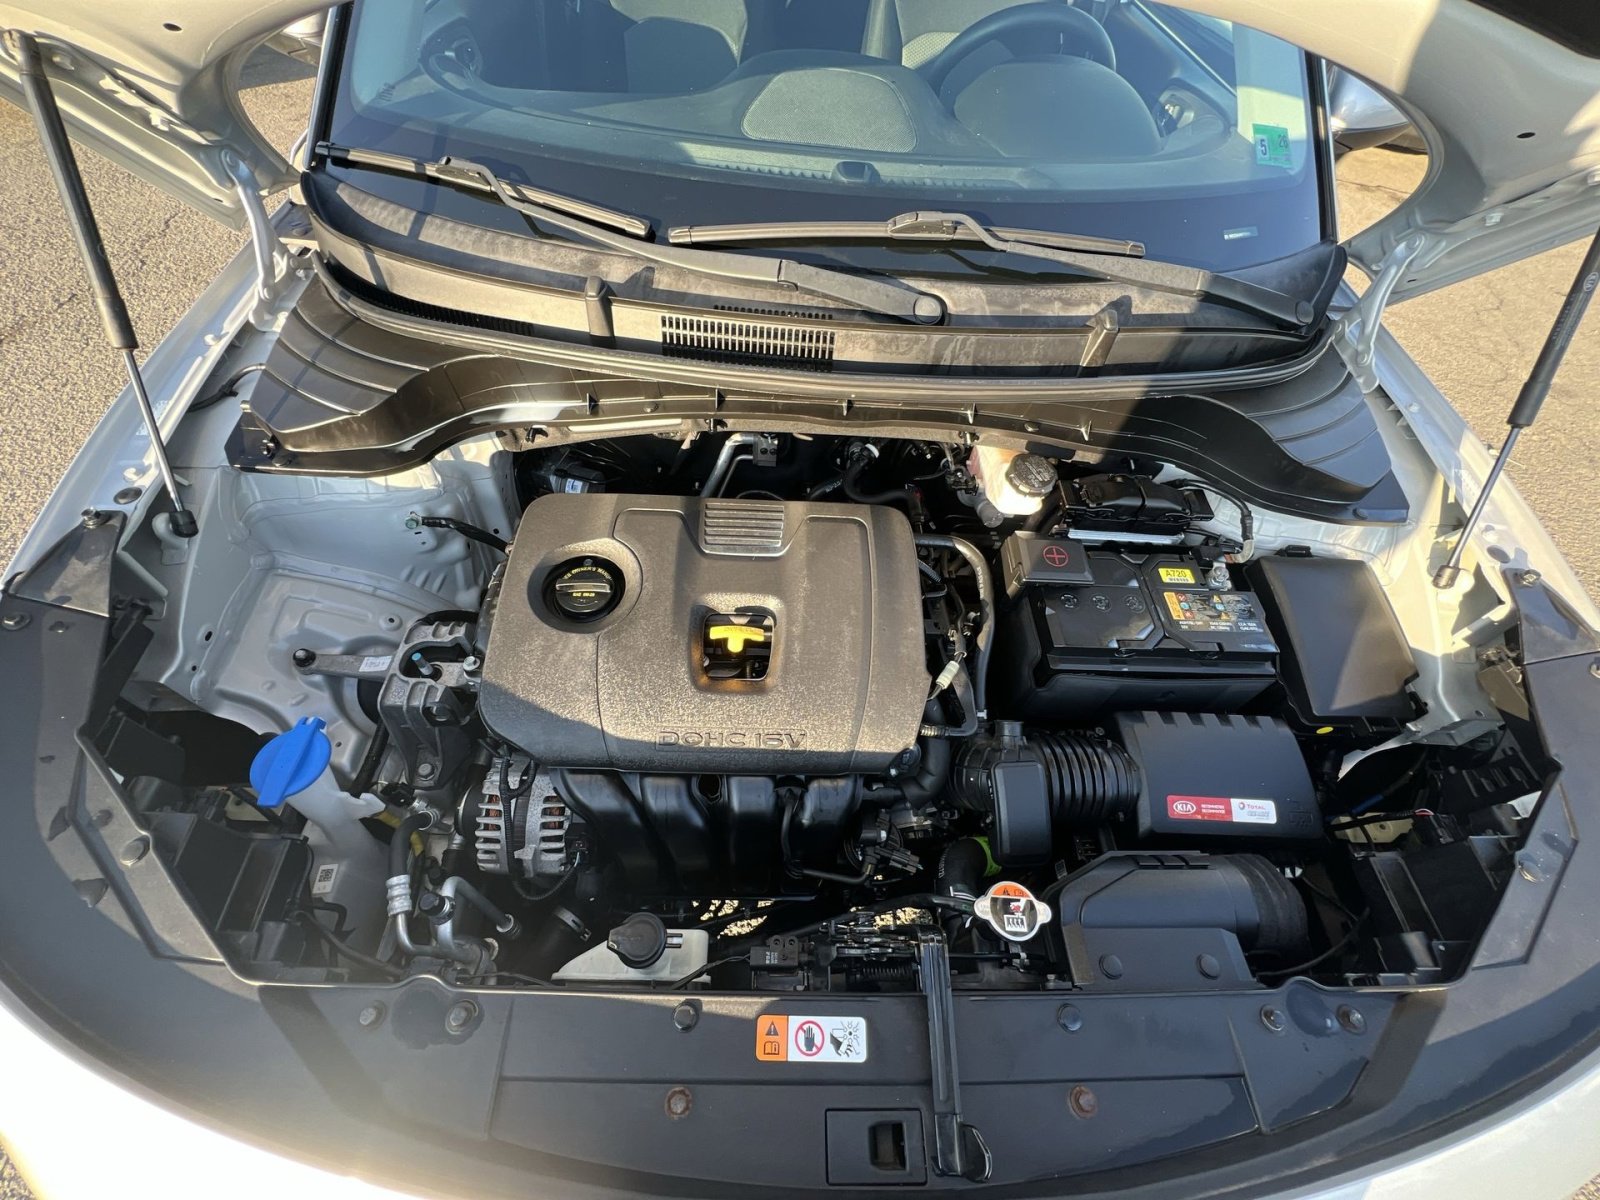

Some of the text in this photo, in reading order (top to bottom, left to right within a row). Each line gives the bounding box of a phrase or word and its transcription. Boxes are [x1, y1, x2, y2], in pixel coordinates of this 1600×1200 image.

[1260, 138, 1267, 156] 5
[1165, 569, 1188, 578] A720
[658, 731, 806, 748] DOHC 16V
[1176, 803, 1193, 812] KIA
